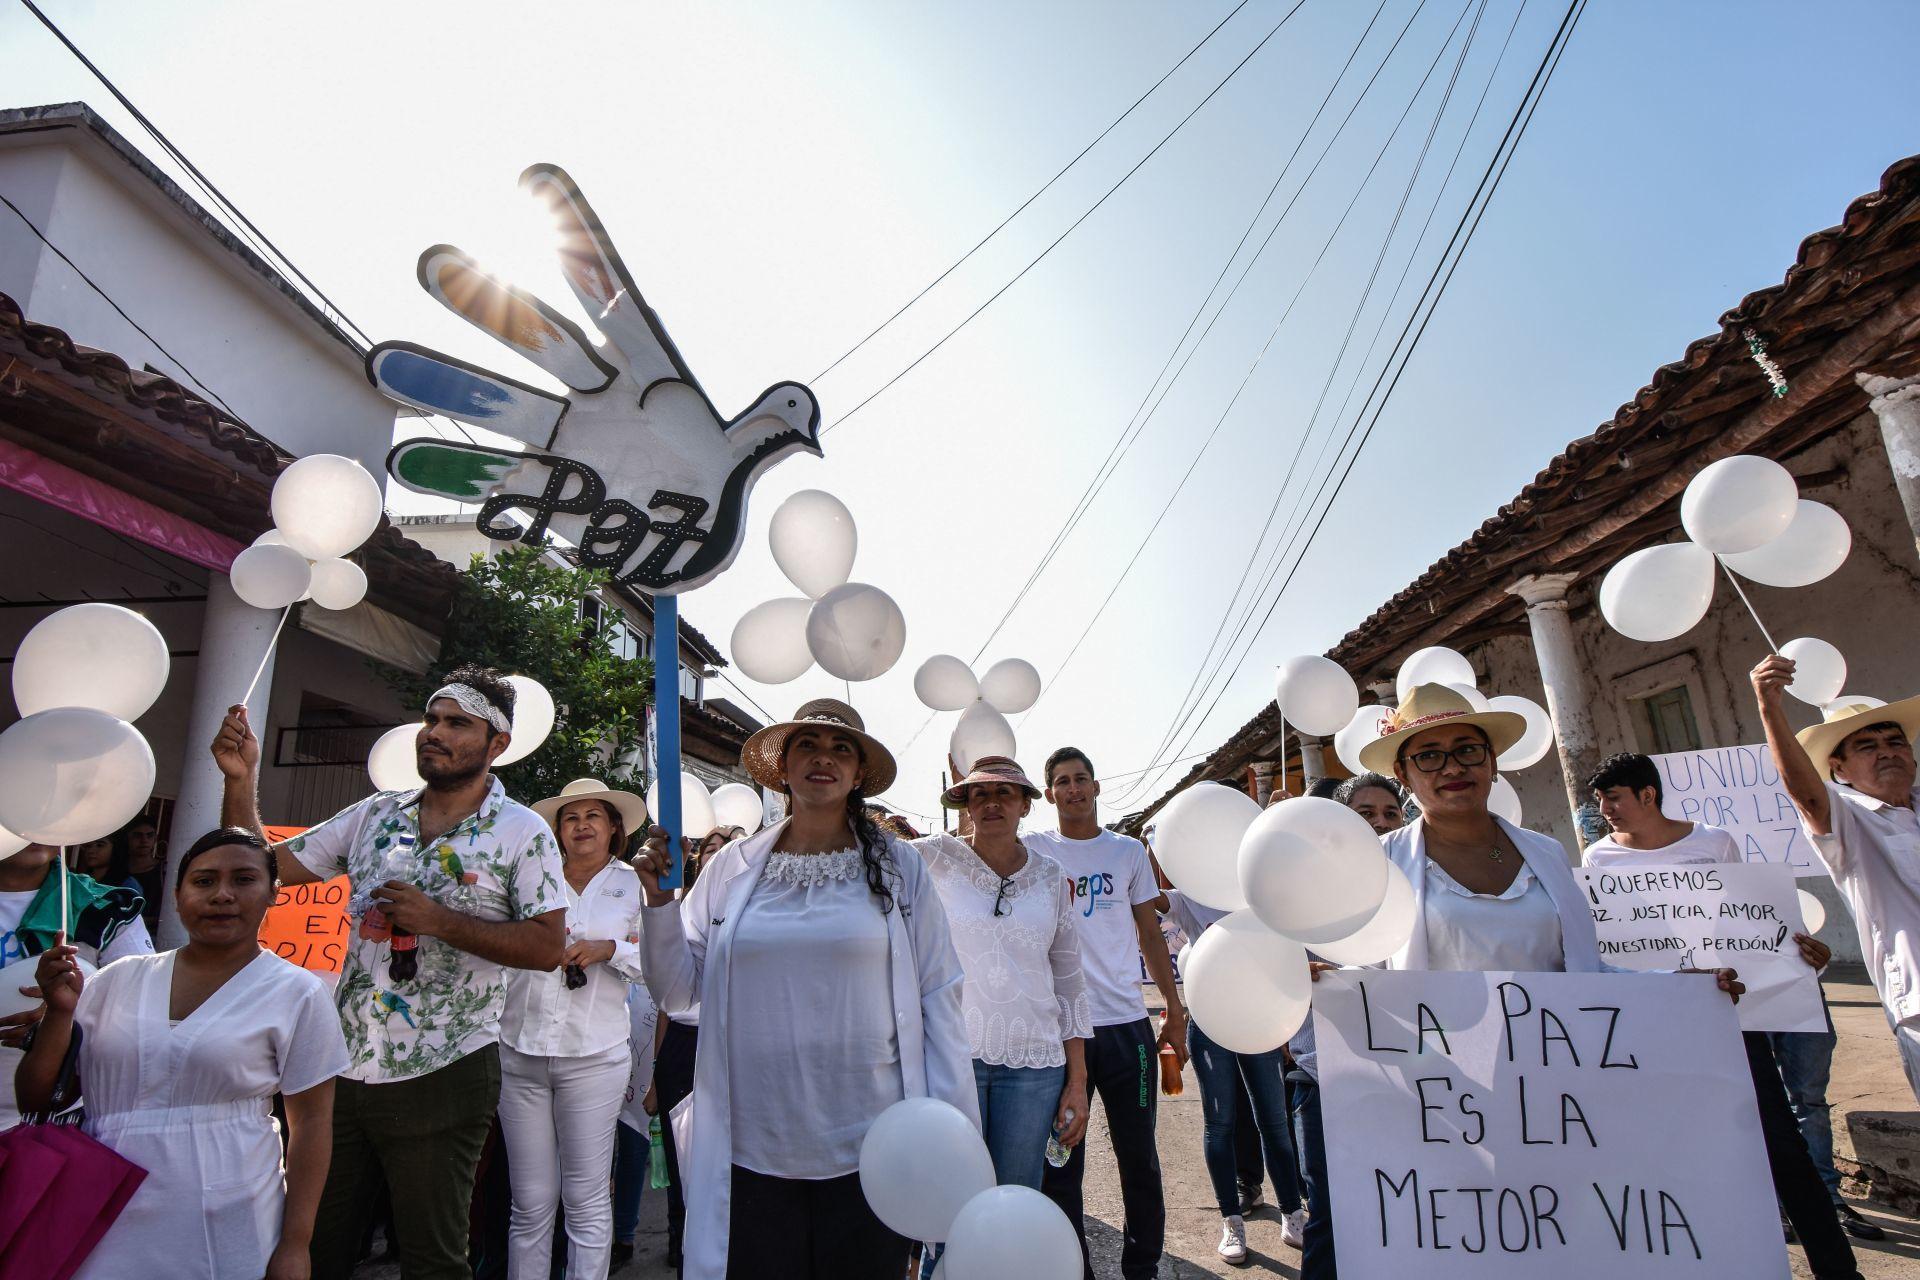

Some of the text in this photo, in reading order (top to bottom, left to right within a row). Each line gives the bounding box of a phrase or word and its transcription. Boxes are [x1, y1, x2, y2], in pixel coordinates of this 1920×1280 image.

[1664, 745, 1779, 791] UNIDO
[1681, 793, 1799, 827] POR LA
[1746, 828, 1809, 866] AZ
[1585, 870, 1723, 905] ¡QUEREMOS
[1598, 925, 1788, 954] ONESTIDAD, PERDÓN!
[1359, 981, 1639, 1069] LA PAZ
[1416, 1075, 1598, 1147] ES LA
[1374, 1168, 1702, 1260] MEJOR VIA
